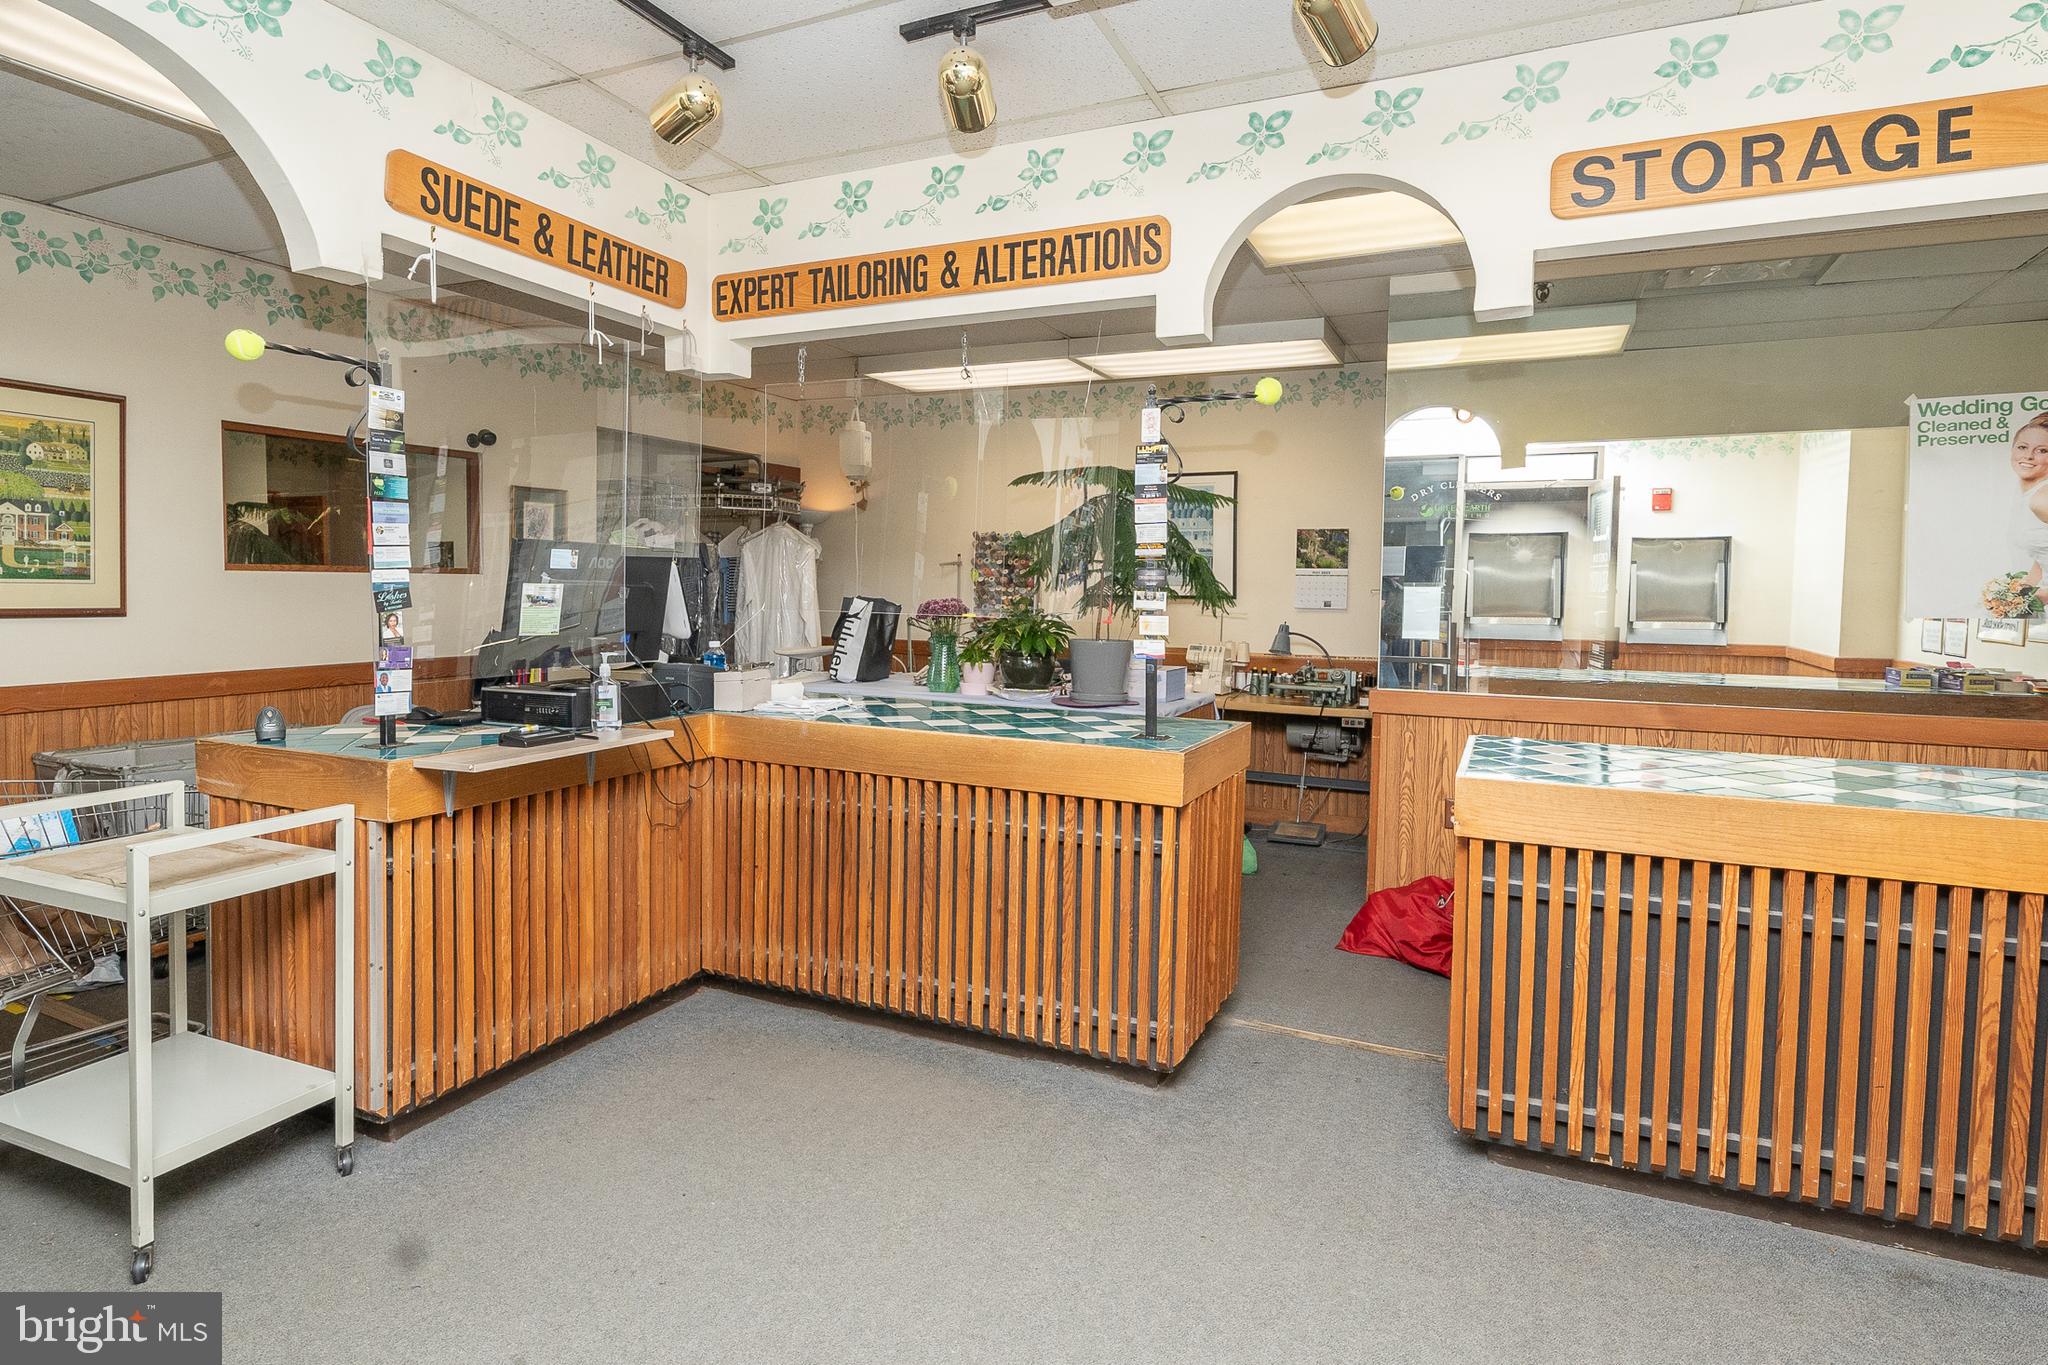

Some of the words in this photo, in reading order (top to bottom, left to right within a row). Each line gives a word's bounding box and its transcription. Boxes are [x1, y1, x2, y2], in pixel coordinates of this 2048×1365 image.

[1570, 106, 1974, 208] STORAGE
[420, 166, 521, 246] SUEDE
[533, 213, 554, 257] &
[567, 223, 669, 298] LEATHER
[716, 271, 799, 316] EXPERT
[808, 254, 928, 305] TAILORING
[939, 250, 961, 288] &
[973, 222, 1164, 286] ALTERATIONS
[1917, 399, 2014, 418] Wedding
[1917, 418, 1992, 434] Cleaned
[1995, 416, 2009, 430] &
[1917, 431, 2010, 448] Preserved
[1410, 484, 1435, 502] DRY
[1440, 480, 1503, 501] CLNERS
